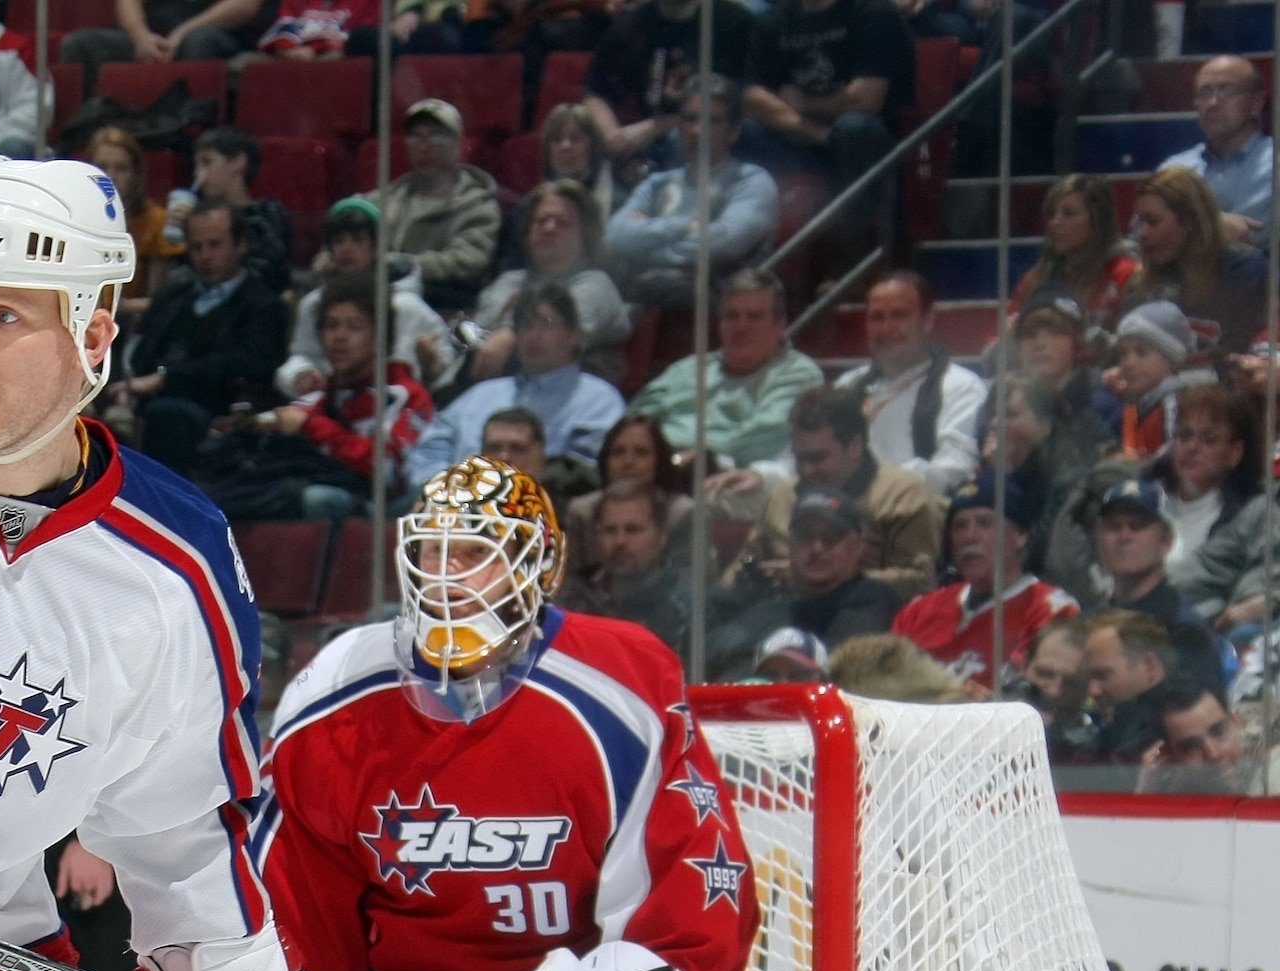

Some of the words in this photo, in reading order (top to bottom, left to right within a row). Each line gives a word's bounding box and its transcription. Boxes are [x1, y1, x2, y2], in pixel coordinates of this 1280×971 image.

[397, 820, 565, 864] EAST
[706, 866, 739, 891] 1993
[482, 881, 571, 937] 30
